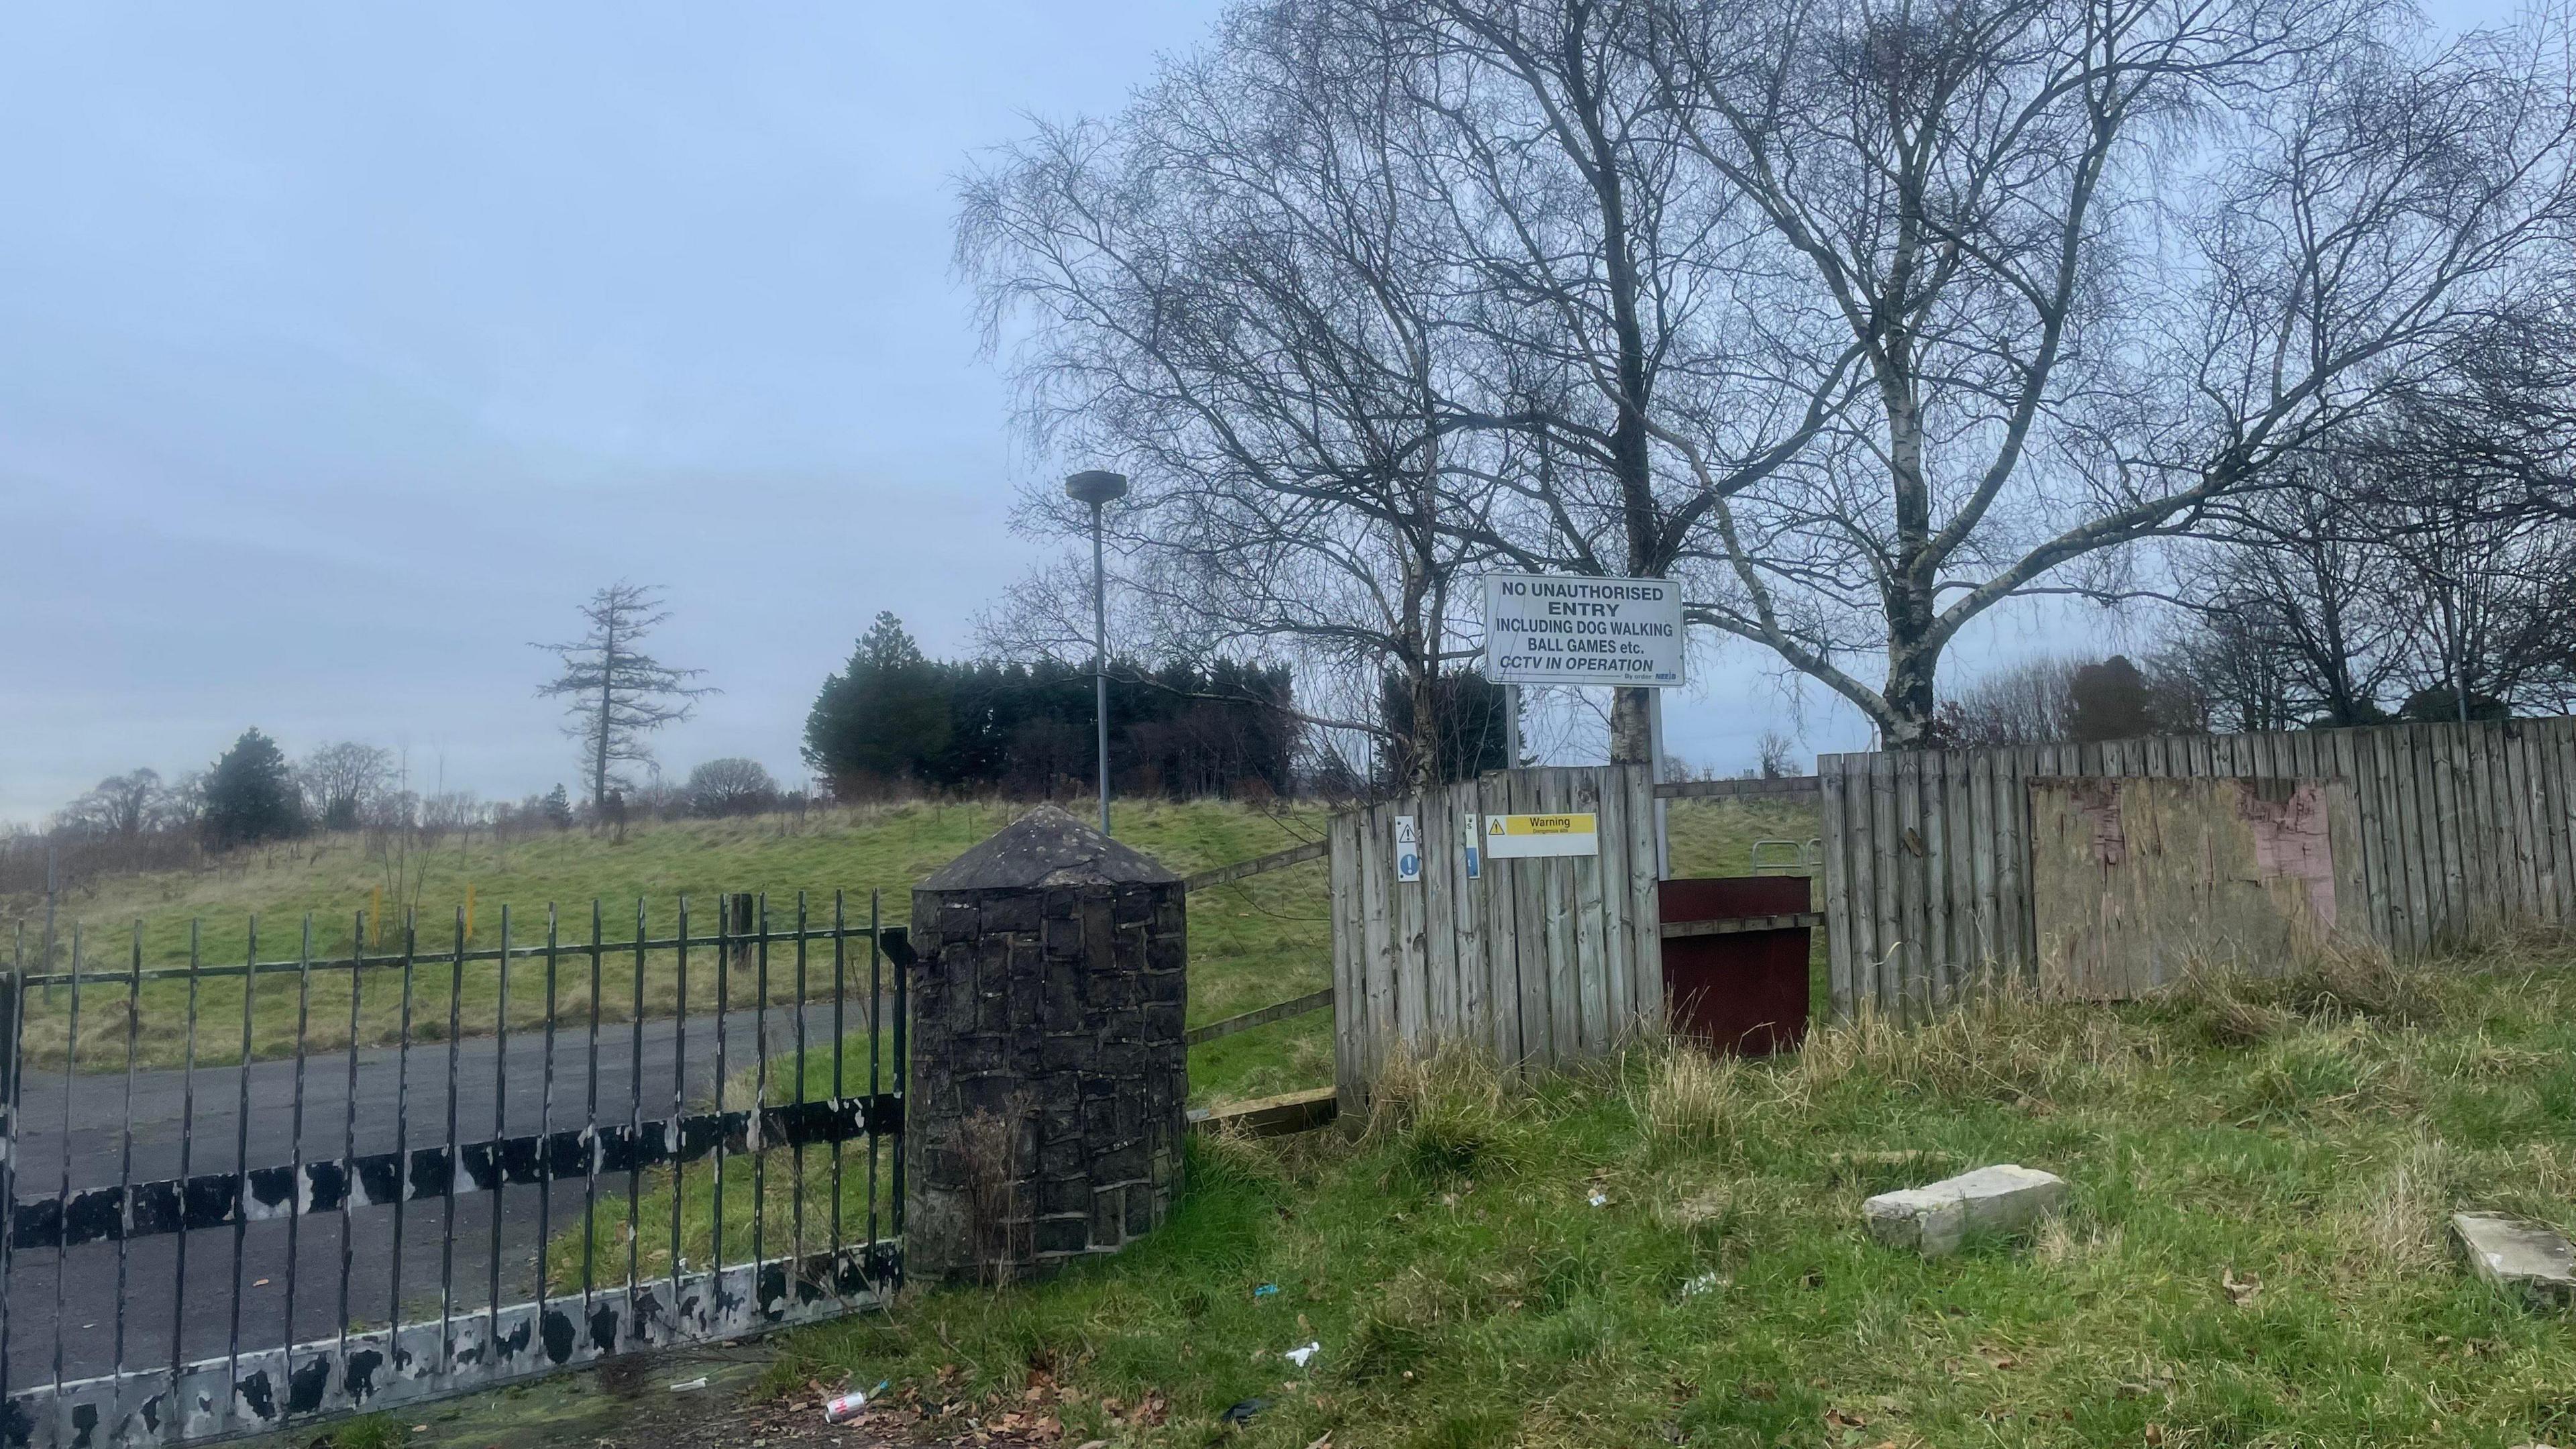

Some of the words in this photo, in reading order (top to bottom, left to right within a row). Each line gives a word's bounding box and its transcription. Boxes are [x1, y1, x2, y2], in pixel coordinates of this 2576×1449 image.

[1502, 582, 1526, 596] NO
[1532, 583, 1664, 600] UNAUTHORISED
[1548, 601, 1620, 616] ENTRY
[1497, 618, 1572, 633] INCLUDING
[1577, 621, 1607, 635] DOG
[1610, 622, 1672, 637] WALKING
[1528, 637, 1564, 651] BALL
[1567, 639, 1616, 653] GAMES
[1620, 641, 1644, 654] etc.
[1500, 655, 1542, 668] CCTV
[1546, 657, 1562, 669] IN
[1566, 657, 1654, 672] OPERATION
[1529, 816, 1570, 828] Warning
